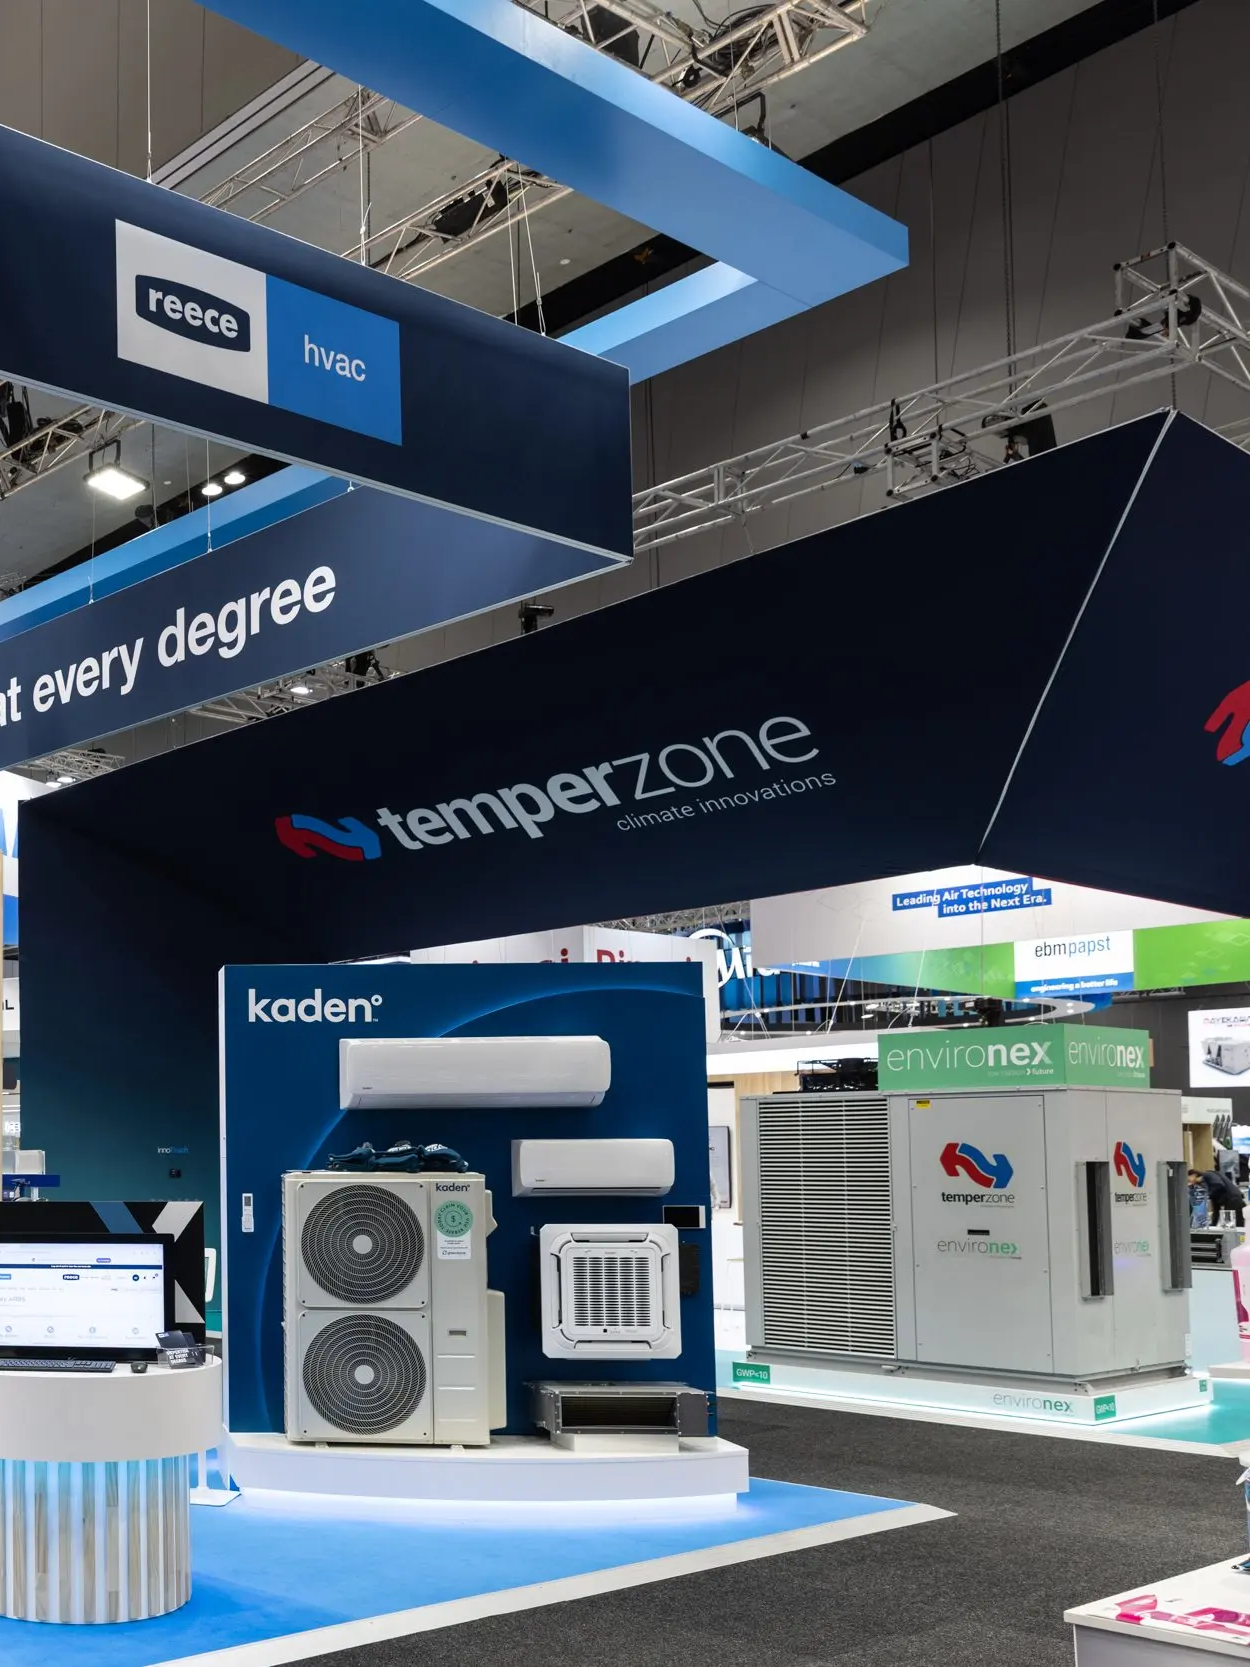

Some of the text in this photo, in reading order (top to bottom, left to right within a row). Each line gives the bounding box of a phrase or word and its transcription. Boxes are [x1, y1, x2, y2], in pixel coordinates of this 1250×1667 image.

[149, 288, 366, 382] reece hvac
[33, 637, 144, 713] every
[157, 566, 336, 668] degree
[378, 715, 819, 851] temperzone
[616, 773, 836, 831] climate innovations
[896, 882, 1029, 907] Leading Air Technology
[943, 894, 1047, 914] into the Next Era.
[1035, 936, 1111, 958] ebmpapst
[887, 1040, 1052, 1071] environex
[1069, 1036, 1145, 1068] environex
[941, 1192, 1015, 1205] temperzone
[736, 1368, 768, 1380] GWP<10
[993, 1393, 1073, 1413] environex
